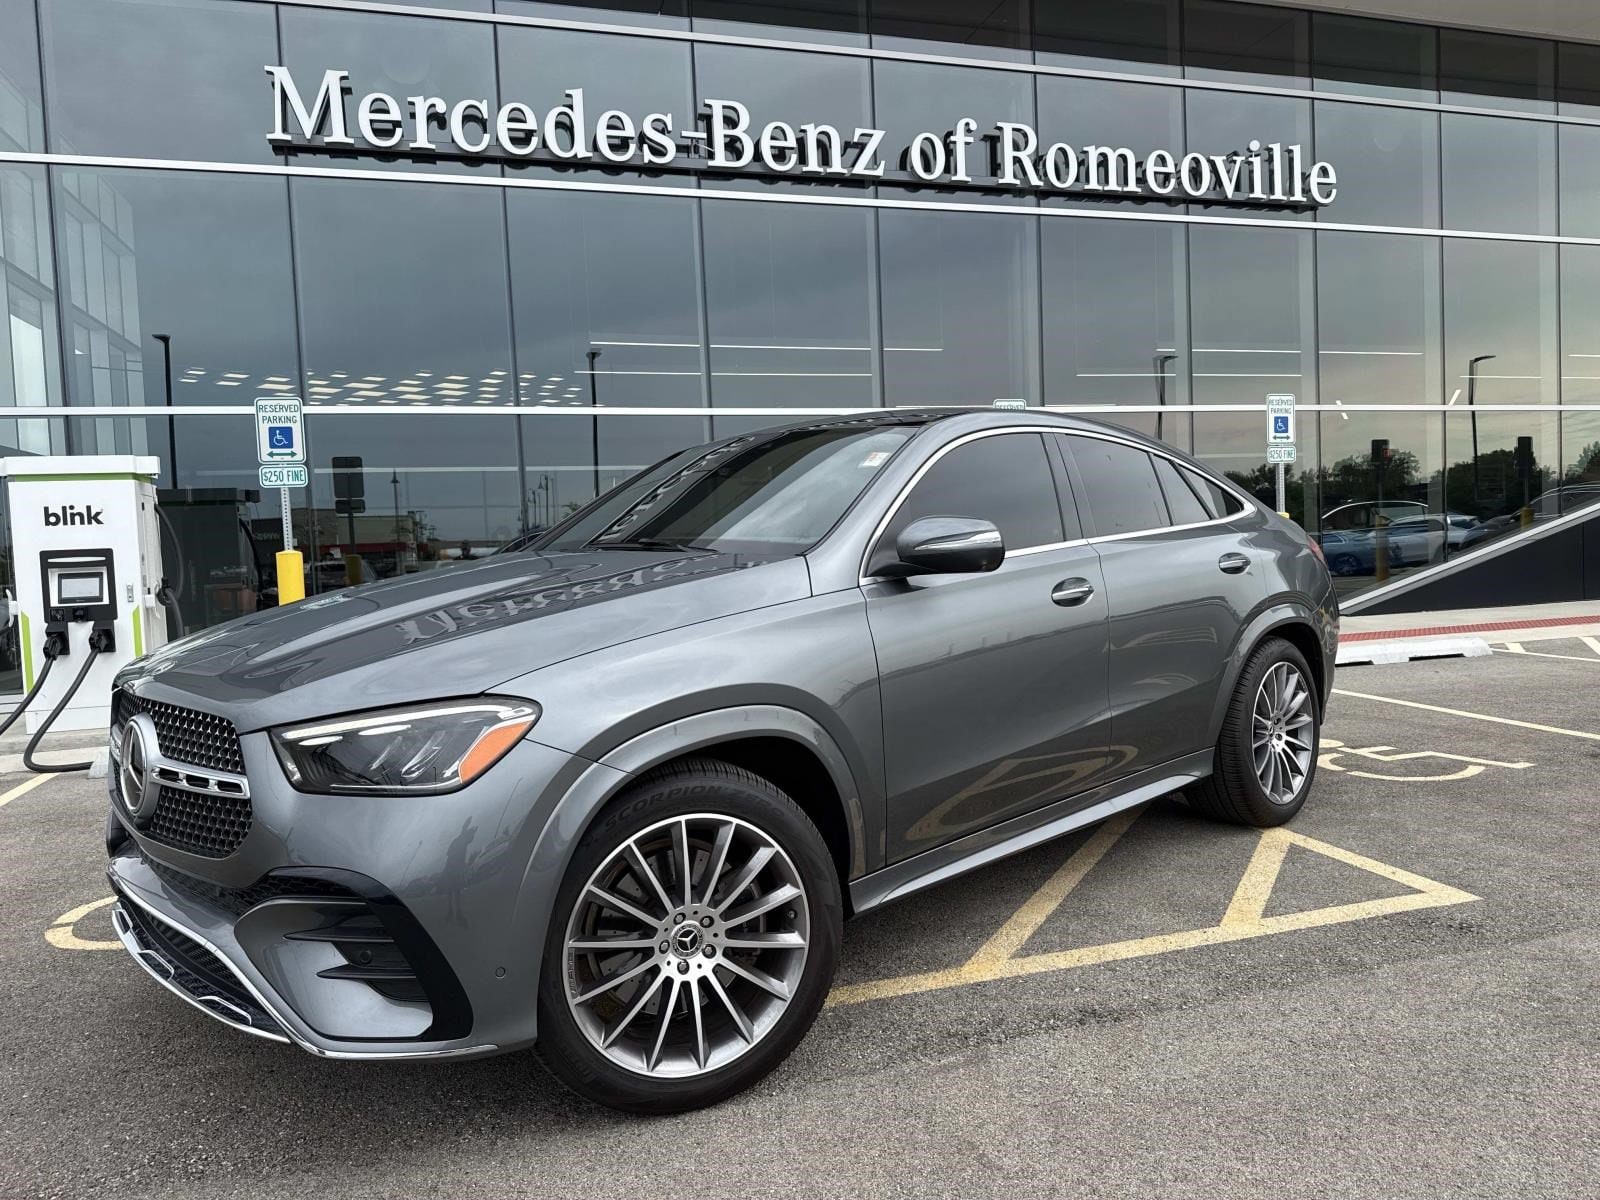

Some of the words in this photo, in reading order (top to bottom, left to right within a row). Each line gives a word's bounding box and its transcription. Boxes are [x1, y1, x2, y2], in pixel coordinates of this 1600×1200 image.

[264, 65, 885, 177] Mercedes-Benz
[911, 118, 977, 184] of
[998, 121, 1337, 204] Romeoville
[258, 404, 299, 413] RESERVED
[262, 416, 297, 424] PARKING
[1270, 450, 1282, 460] $250
[1283, 450, 1294, 459] FINE
[263, 471, 284, 483] $250
[286, 470, 304, 482] FINE
[43, 505, 104, 526] blink
[605, 784, 721, 829] SCORPION
